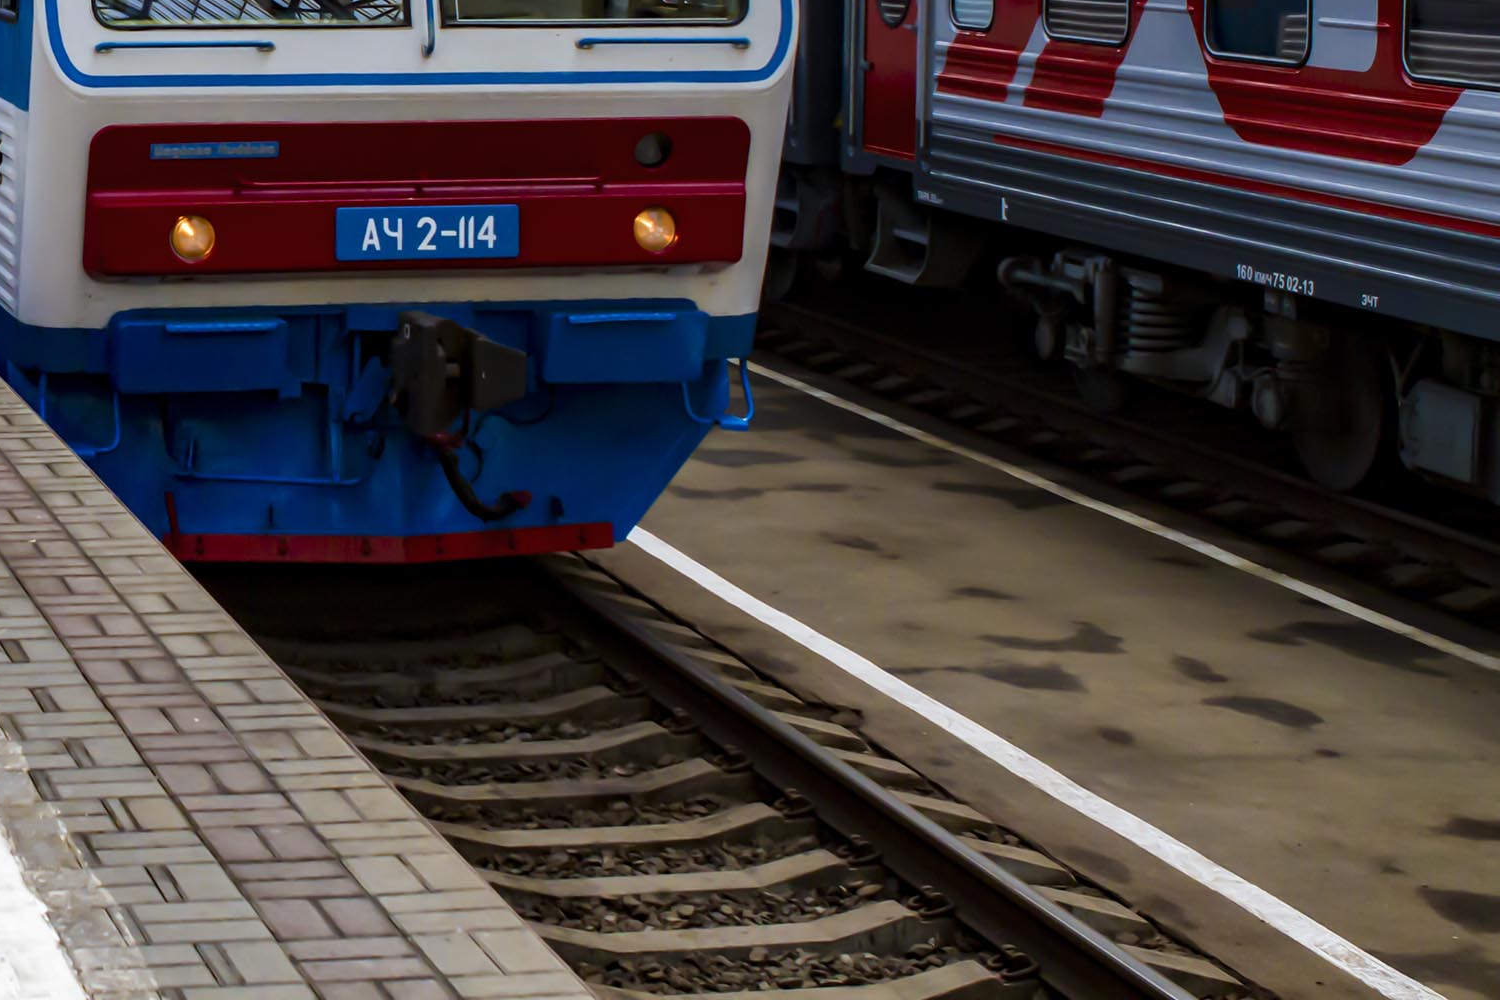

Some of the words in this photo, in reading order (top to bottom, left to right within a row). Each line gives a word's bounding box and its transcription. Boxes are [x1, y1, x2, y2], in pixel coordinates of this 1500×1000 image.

[362, 218, 403, 251] АЧ
[416, 215, 497, 250] 2-114
[1236, 263, 1253, 281] 160
[1286, 275, 1314, 296] 02-13
